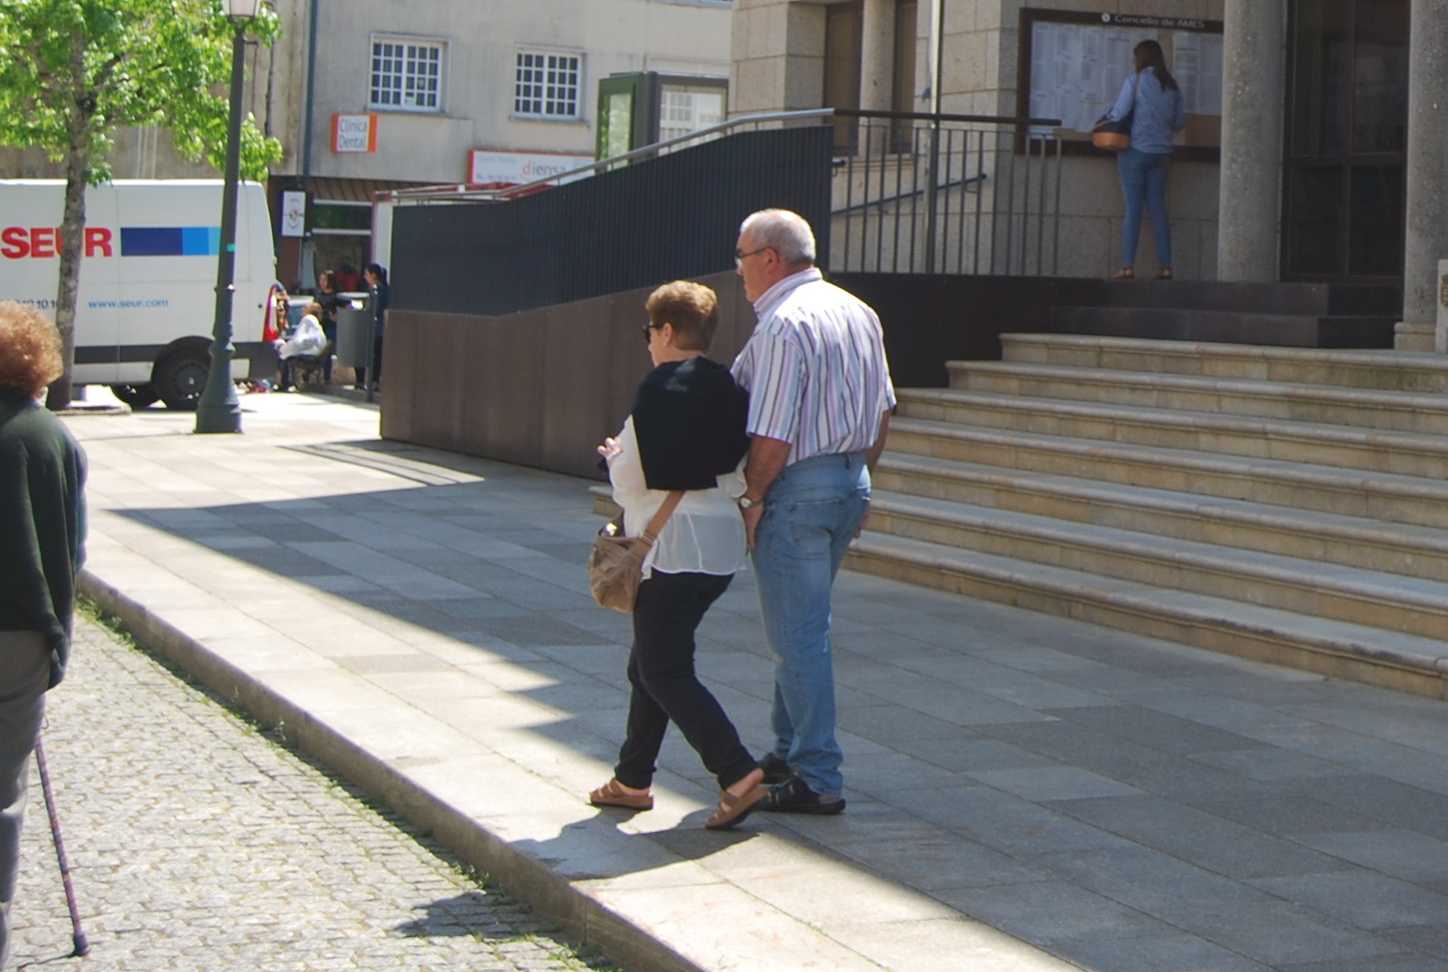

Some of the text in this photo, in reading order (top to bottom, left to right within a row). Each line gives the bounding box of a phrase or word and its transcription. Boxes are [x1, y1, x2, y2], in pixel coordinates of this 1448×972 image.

[1114, 14, 1205, 28] Concello de AMES
[338, 134, 366, 149] Dental
[88, 298, 169, 309] www.seur.com
